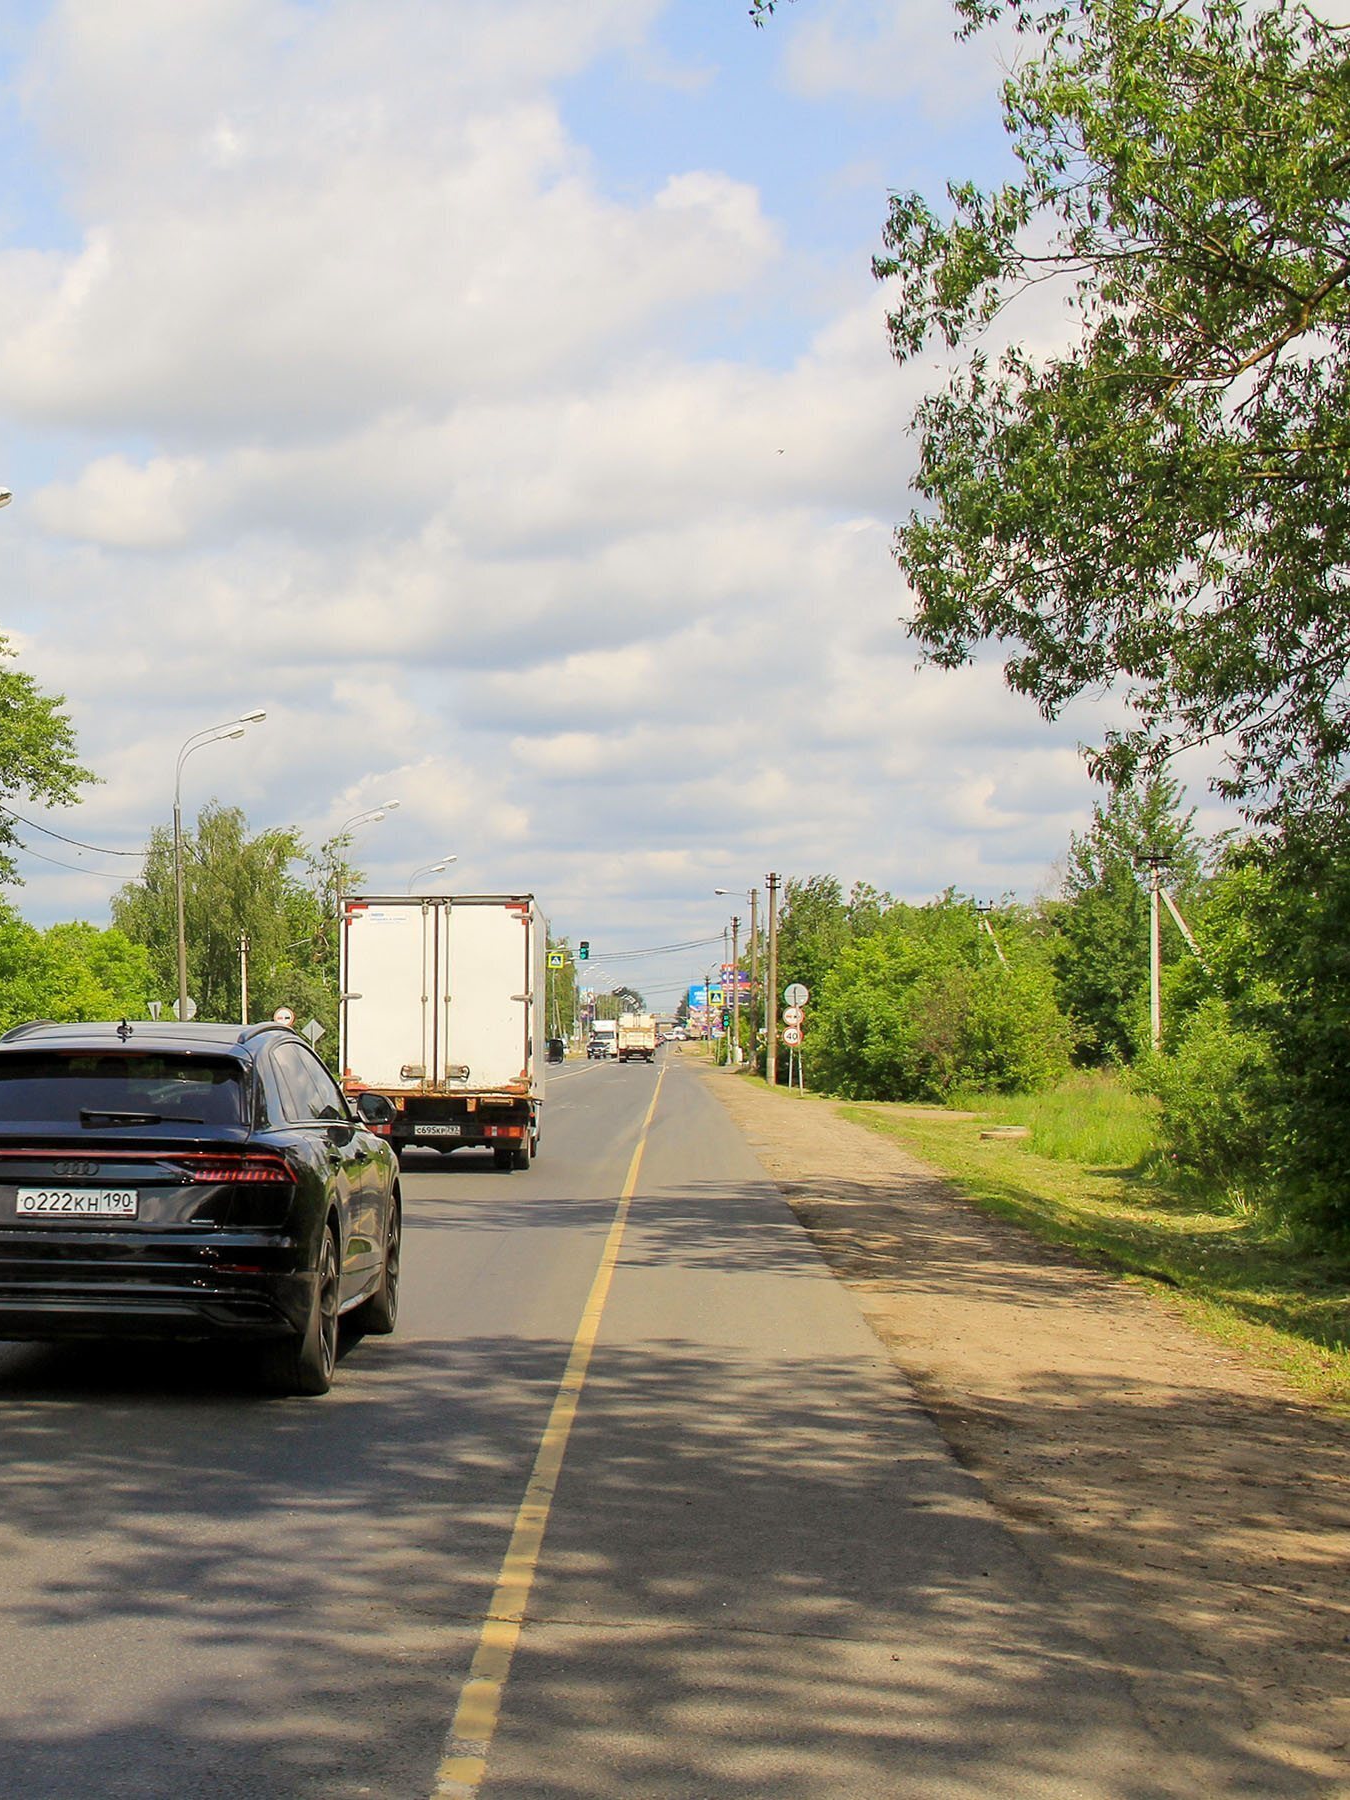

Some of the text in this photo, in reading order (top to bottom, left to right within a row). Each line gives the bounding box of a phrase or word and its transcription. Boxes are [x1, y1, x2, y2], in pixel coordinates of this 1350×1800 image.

[786, 1032, 798, 1040] 40
[23, 1192, 130, 1211] О222КН 190
